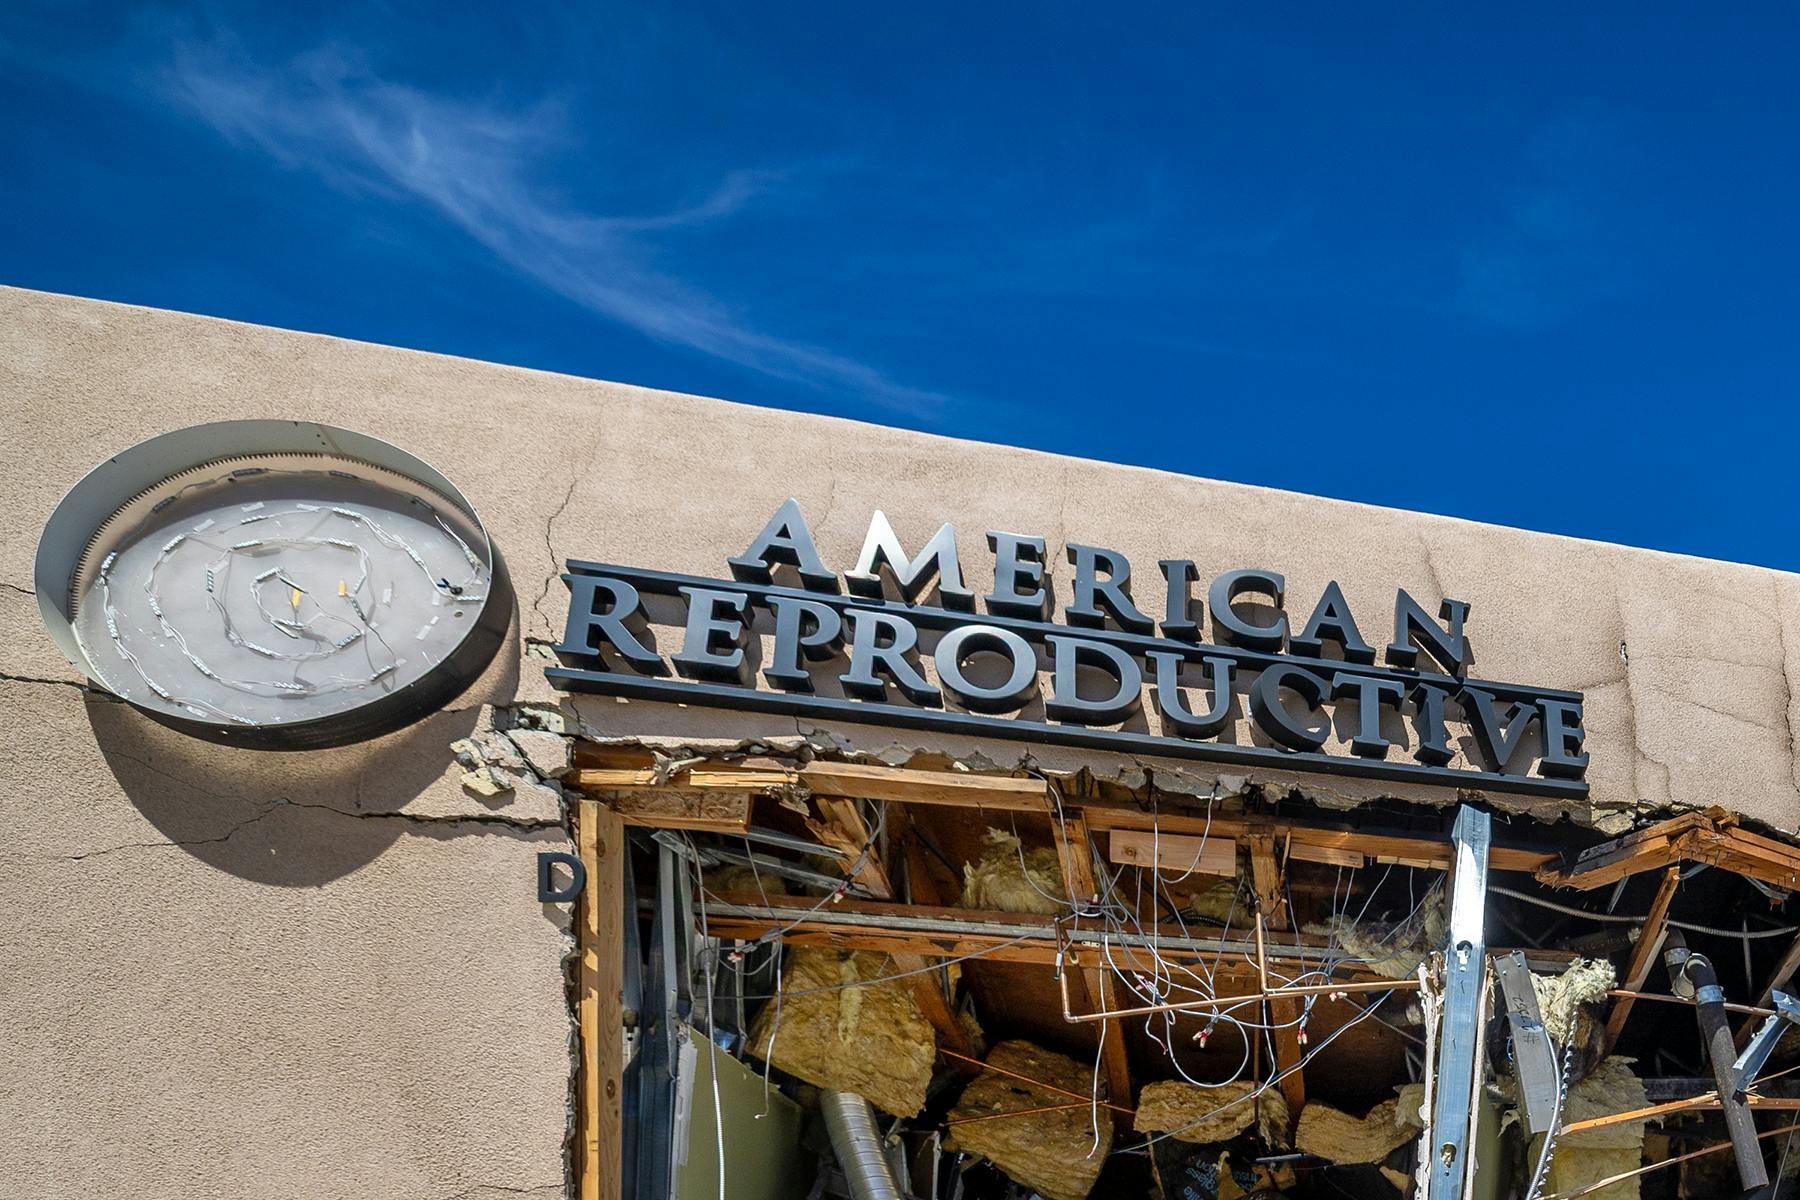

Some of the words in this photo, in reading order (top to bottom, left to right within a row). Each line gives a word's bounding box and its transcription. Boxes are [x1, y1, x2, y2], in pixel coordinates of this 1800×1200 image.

[553, 572, 1590, 778] REPRODUCTIVE
[728, 497, 1471, 680] AMERICAN
[537, 852, 587, 903] D
